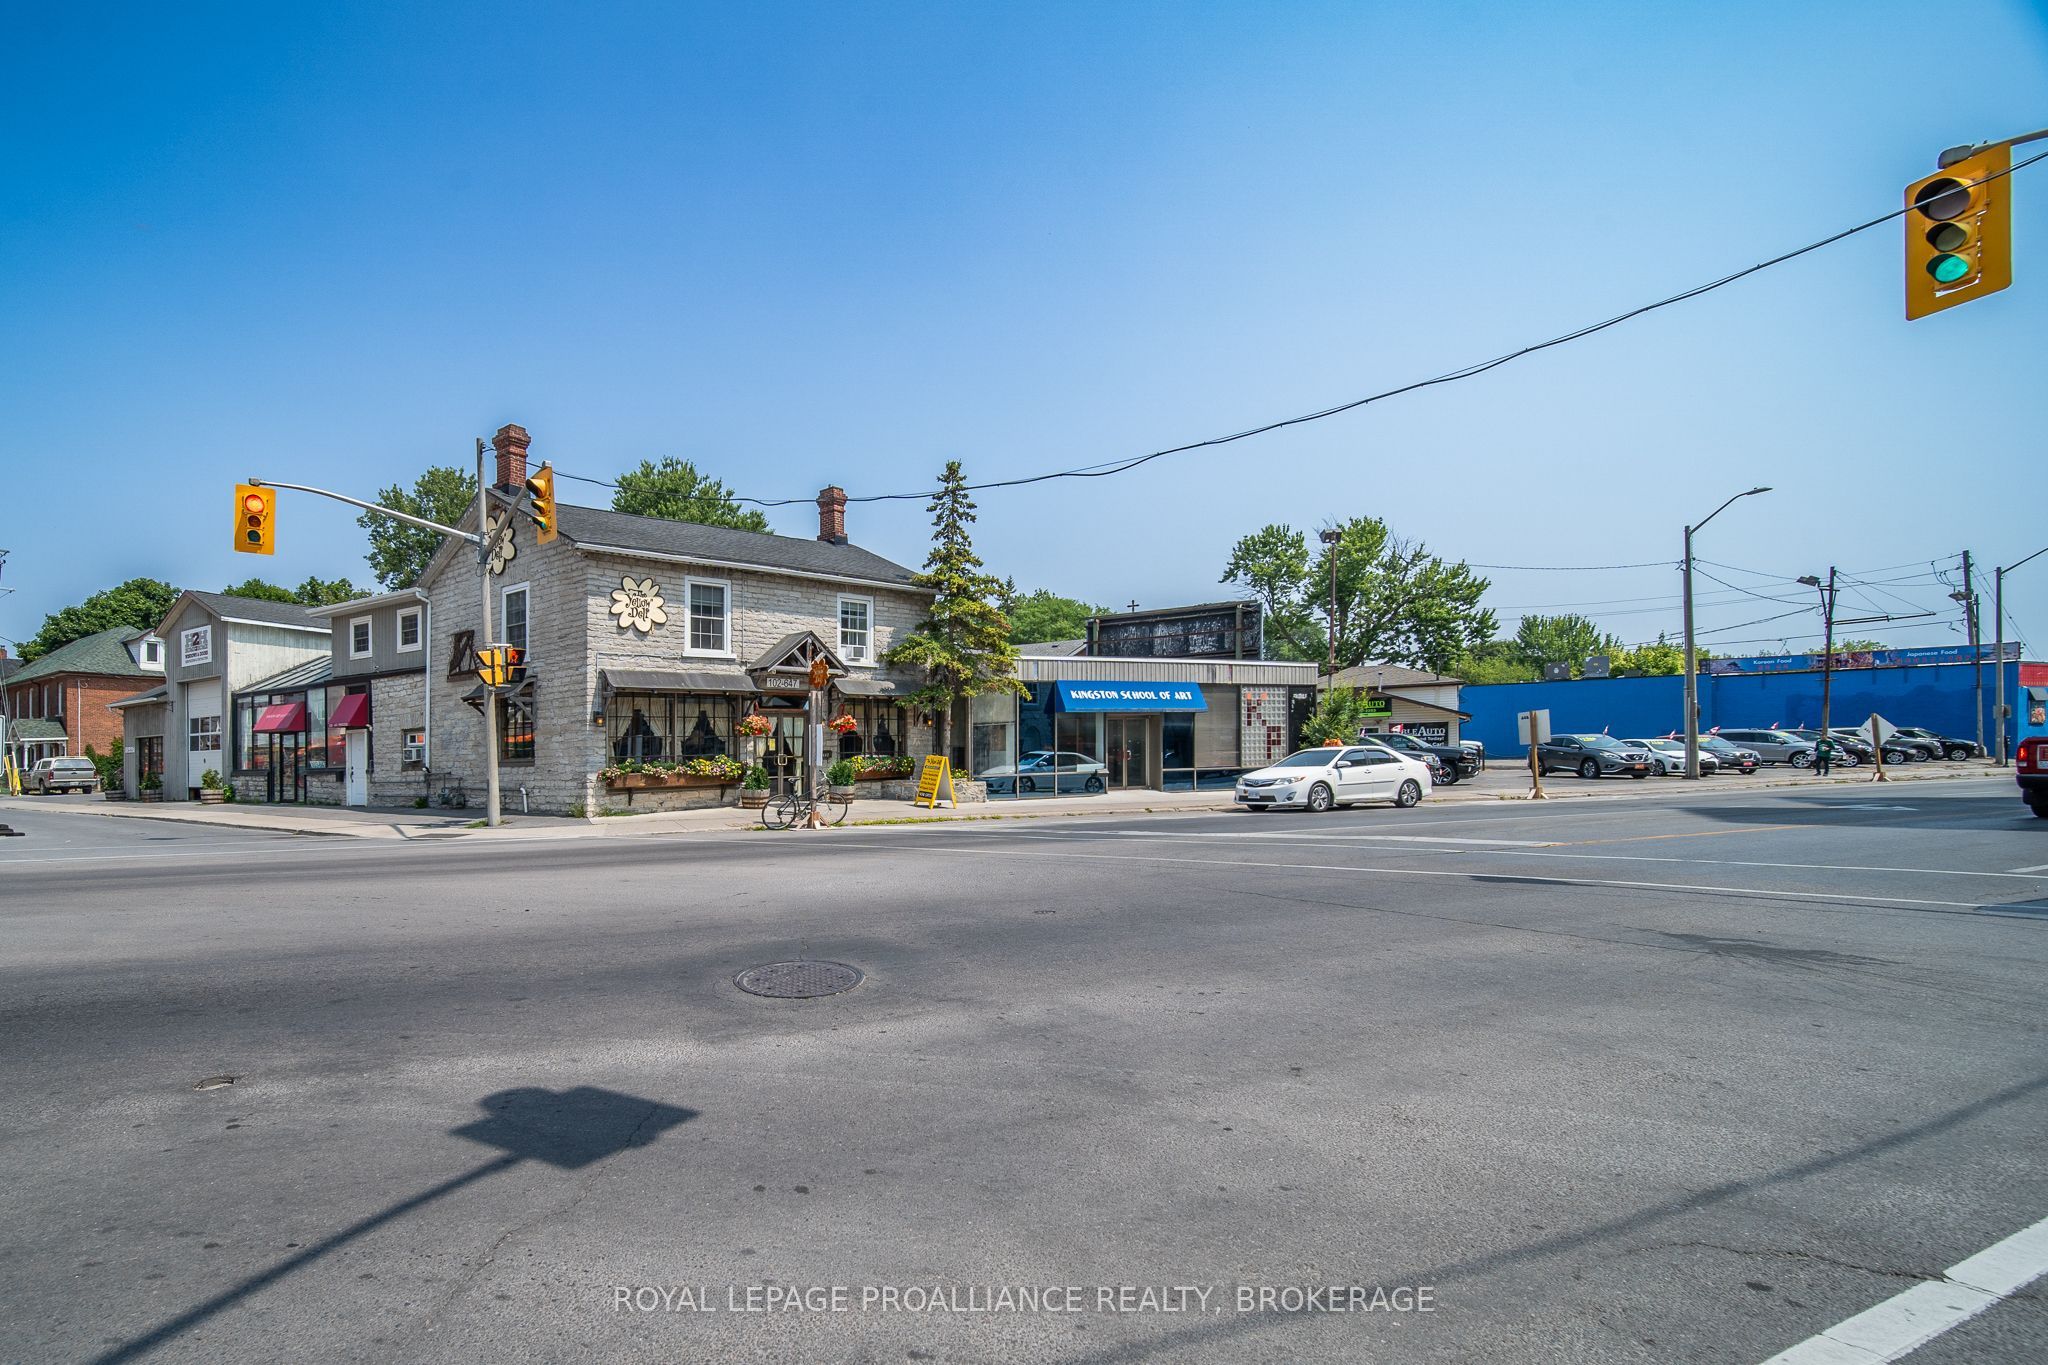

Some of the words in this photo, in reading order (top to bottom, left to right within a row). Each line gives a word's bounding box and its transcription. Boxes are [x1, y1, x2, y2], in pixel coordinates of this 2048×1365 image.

[628, 588, 648, 598] The
[625, 594, 653, 608] Yellow
[628, 607, 649, 622] Deli
[769, 678, 798, 688] 102-647
[1070, 690, 1119, 699] KINGSTON
[1120, 691, 1158, 700] SCHOOL
[1159, 691, 1170, 700] OF
[1174, 692, 1192, 700] ART
